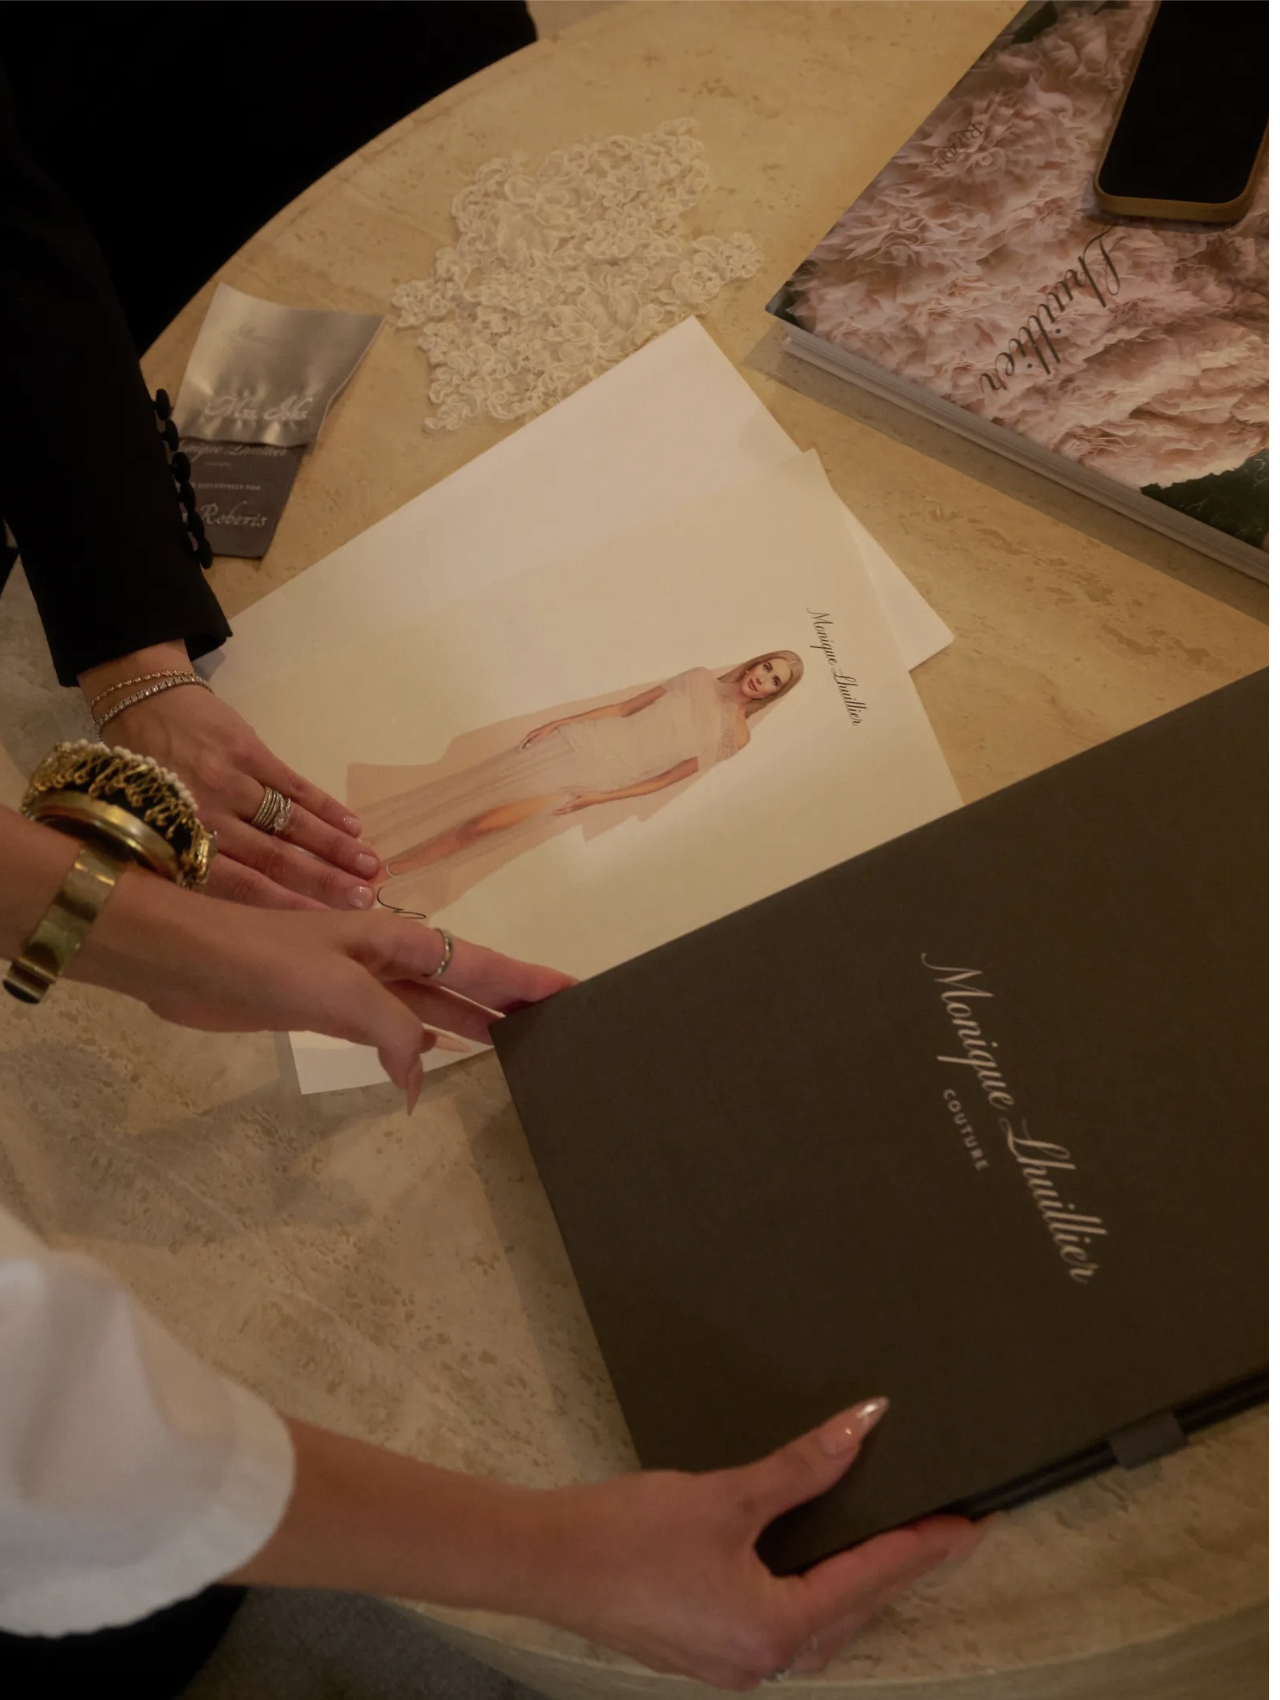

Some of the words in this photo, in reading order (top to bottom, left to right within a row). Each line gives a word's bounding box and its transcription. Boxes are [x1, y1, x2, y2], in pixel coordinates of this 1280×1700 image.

[979, 217, 1126, 393] Lhuillier
[200, 500, 268, 528] Roberts
[806, 607, 838, 666] Monique
[831, 668, 869, 727] Lhuillier
[920, 952, 1014, 1111] Monique
[999, 1116, 1108, 1285] Lhuillier
[942, 1088, 990, 1172] COUTURE
